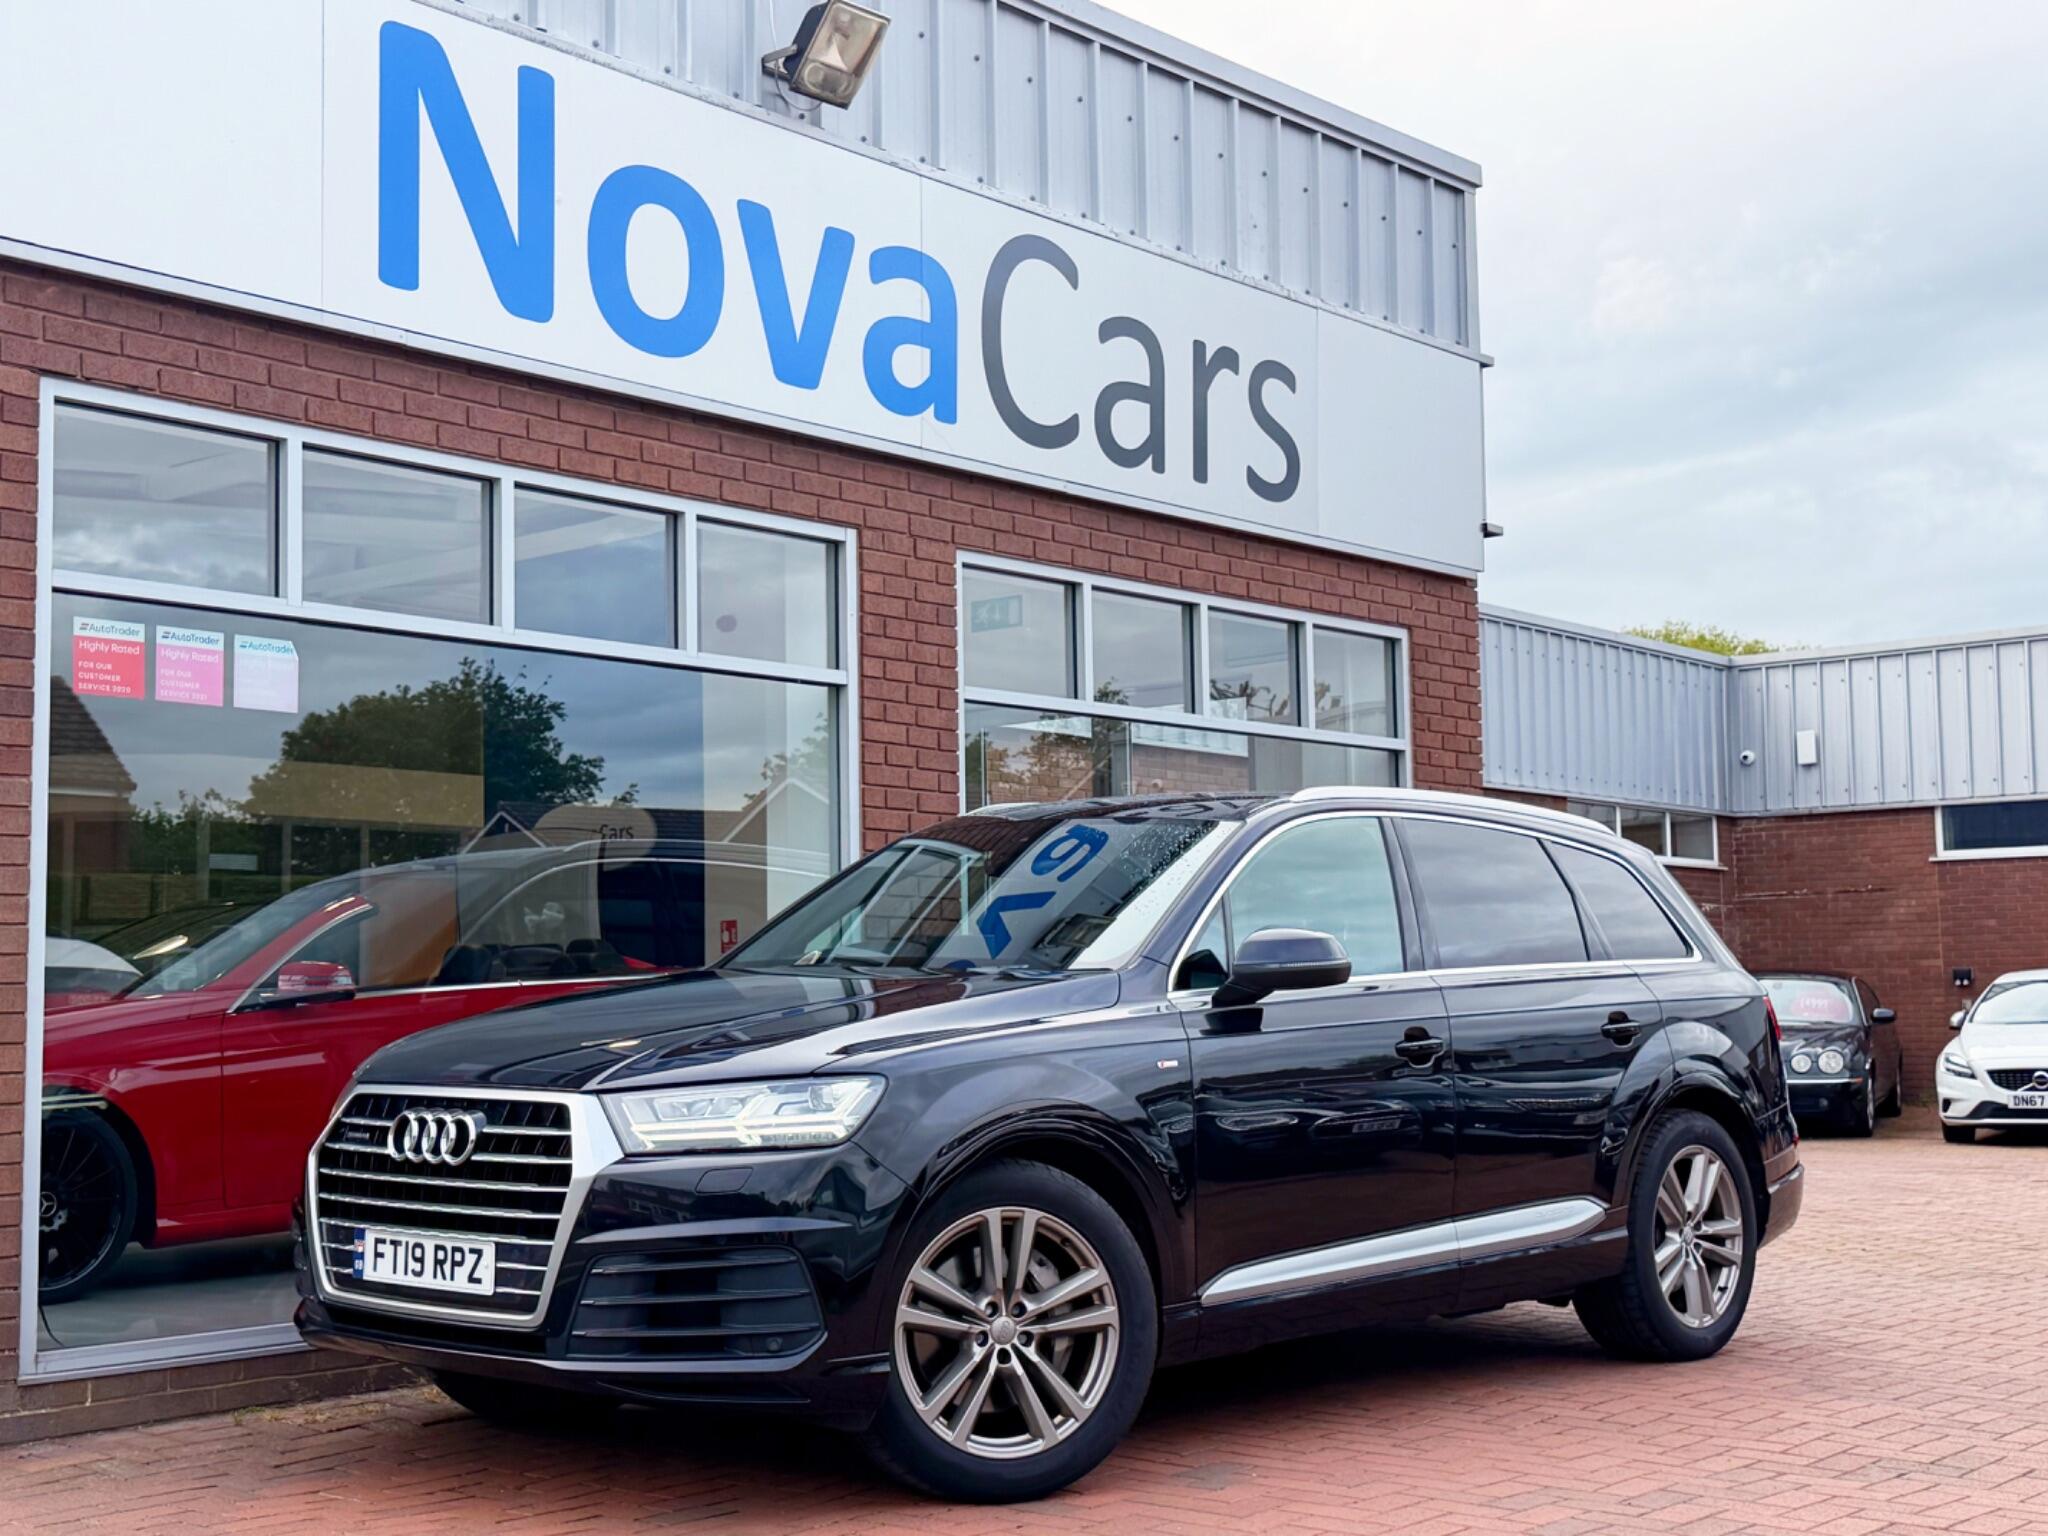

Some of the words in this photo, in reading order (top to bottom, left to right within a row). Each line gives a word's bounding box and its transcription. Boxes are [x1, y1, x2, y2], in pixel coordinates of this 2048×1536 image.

[89, 623, 141, 637] AutoTrader
[170, 632, 220, 646] AutoTrader
[79, 640, 110, 653] Highly
[111, 643, 140, 656] Rated
[78, 671, 121, 682] CUSTOMER
[2012, 1095, 2045, 1107] DN67
[373, 1237, 426, 1278] FT19
[432, 1243, 484, 1285] RPZ
